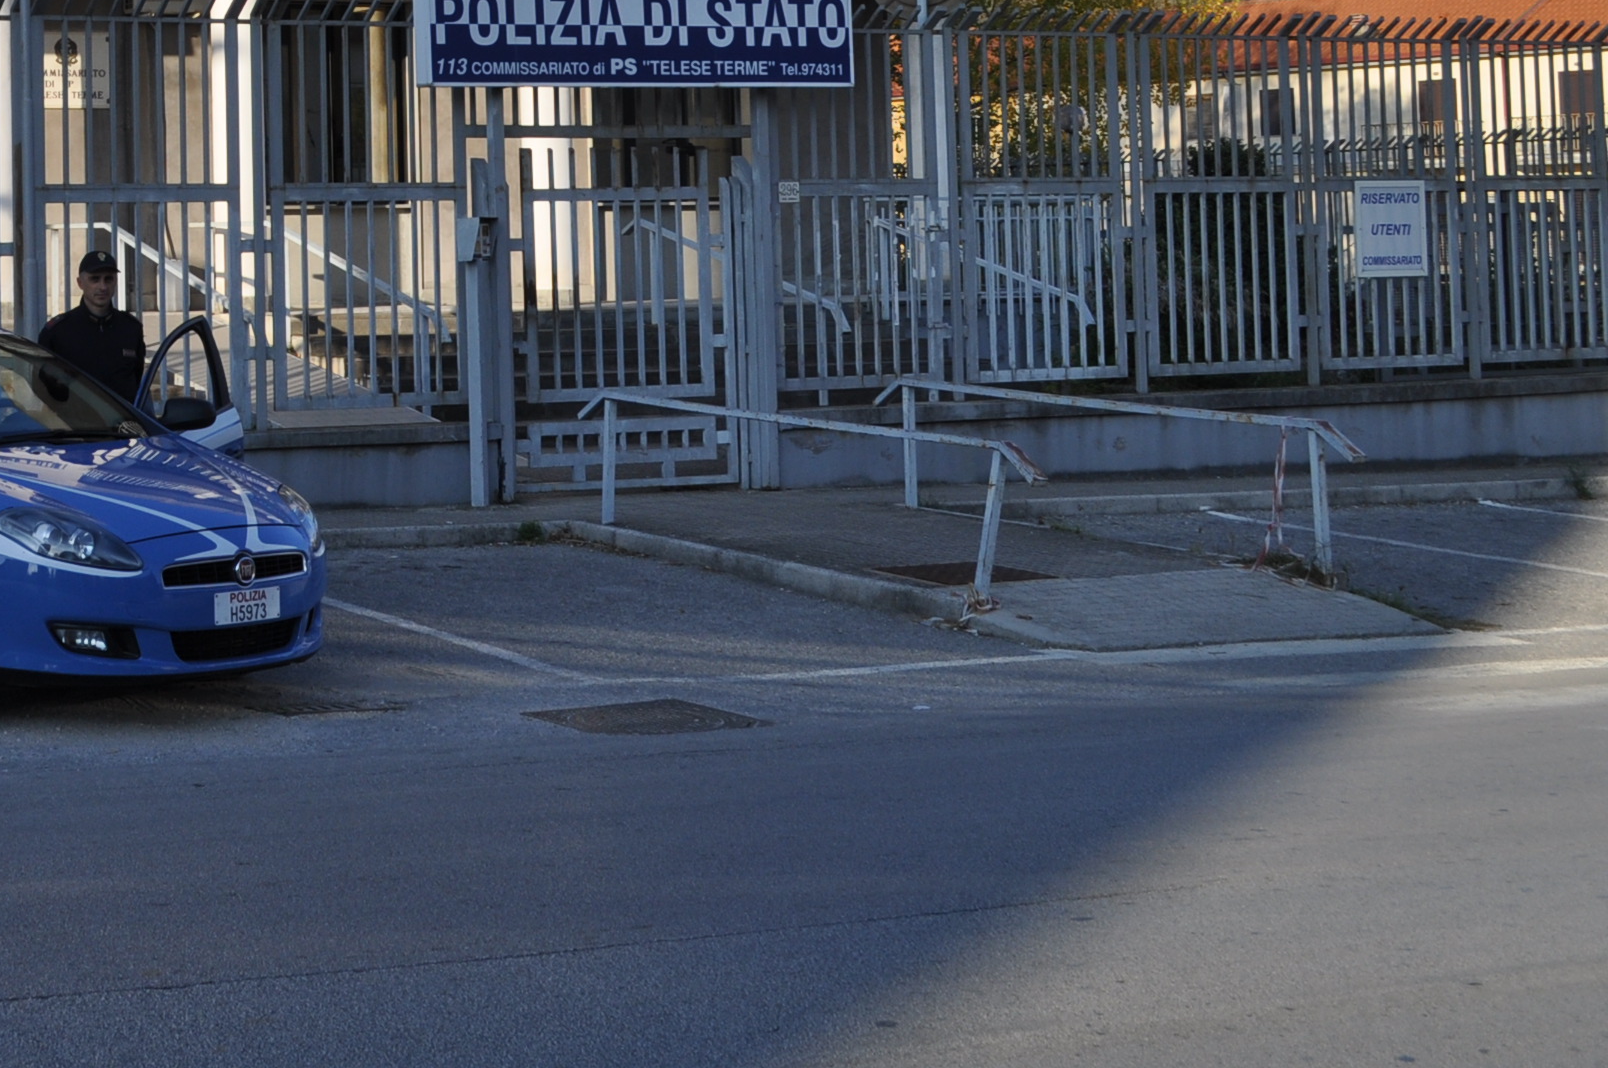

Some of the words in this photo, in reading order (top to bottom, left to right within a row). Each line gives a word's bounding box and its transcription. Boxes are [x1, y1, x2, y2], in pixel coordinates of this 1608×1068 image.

[437, 58, 468, 75] 113
[472, 61, 589, 75] COMMISSARIATO
[593, 61, 605, 75] di
[610, 58, 638, 75] PS
[642, 59, 711, 75] "TELESE
[714, 60, 775, 76] TERME"
[780, 62, 843, 76] Tel.974311
[1360, 192, 1420, 204] RISERVATO
[1371, 224, 1411, 236] UTENTI
[1362, 255, 1422, 266] COMMISSARIATO
[230, 590, 267, 604] POLIZIA
[230, 603, 267, 622] H5973
